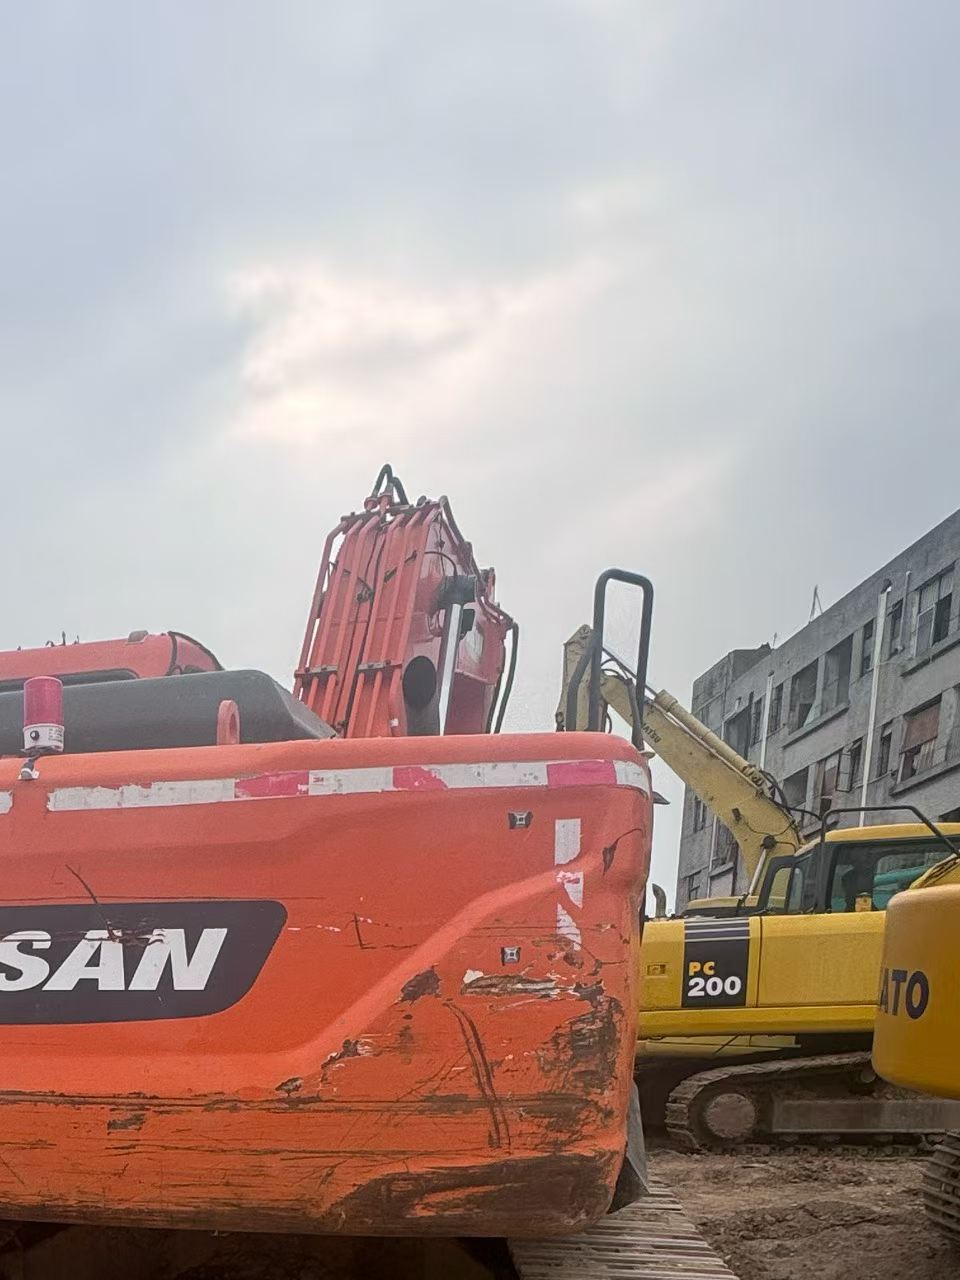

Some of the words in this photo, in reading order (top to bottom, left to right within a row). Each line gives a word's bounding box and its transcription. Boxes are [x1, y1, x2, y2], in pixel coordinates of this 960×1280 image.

[642, 722, 662, 744] ATSU
[689, 961, 715, 976] PC
[688, 976, 742, 997] 200
[880, 968, 930, 1020] ATO
